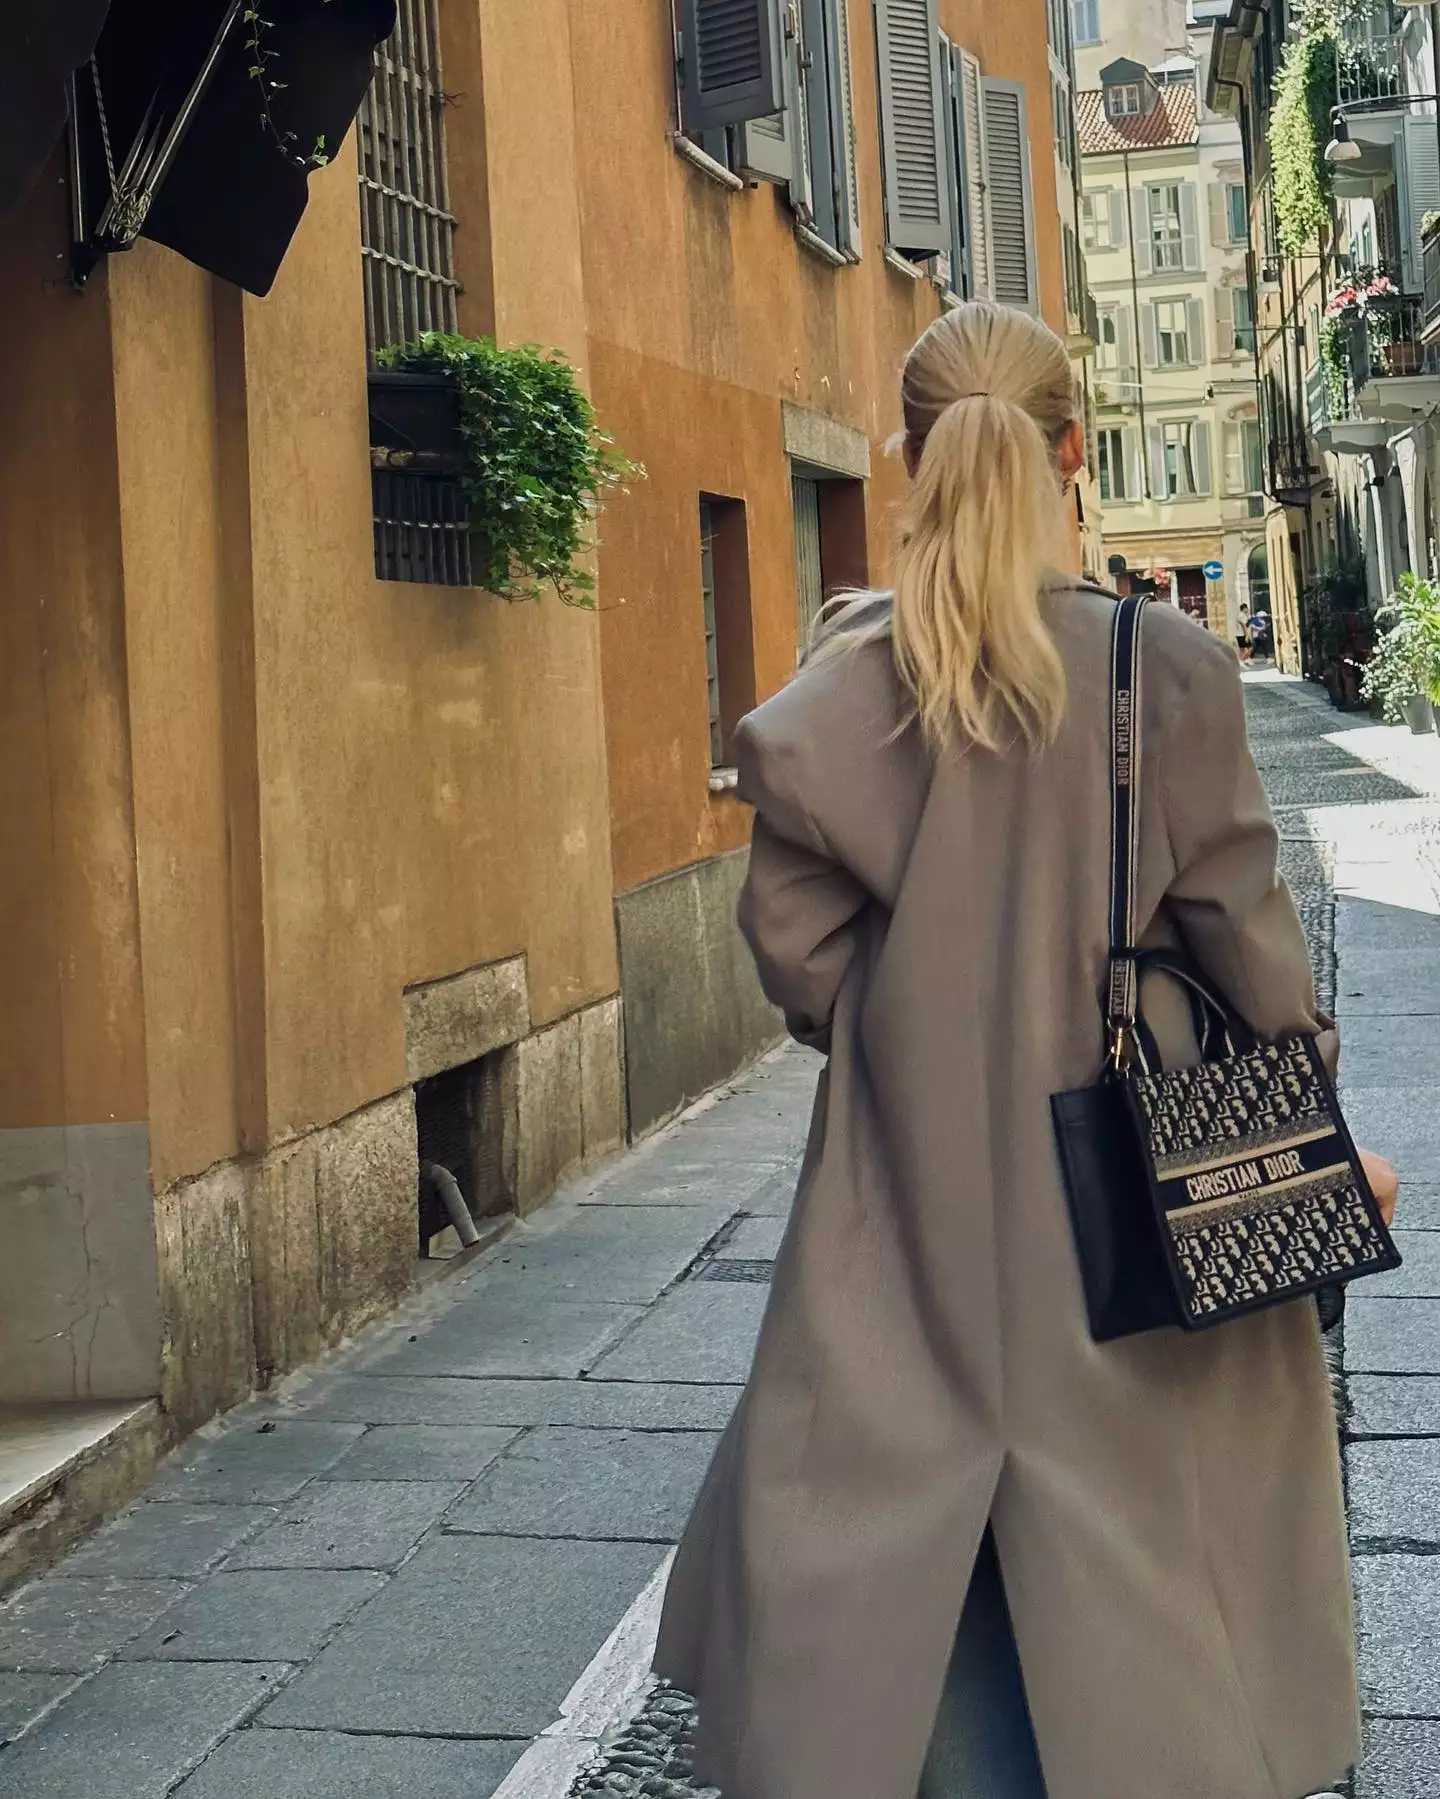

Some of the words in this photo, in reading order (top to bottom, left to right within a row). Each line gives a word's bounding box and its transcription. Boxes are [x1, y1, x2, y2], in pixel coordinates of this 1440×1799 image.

[1117, 689, 1130, 753] CHRISTIAN
[1117, 757, 1129, 785] DIOR
[1112, 960, 1126, 1016] HRISTIAN
[1186, 1161, 1262, 1201] CHRISTIAN
[1263, 1150, 1305, 1181] DIOR
